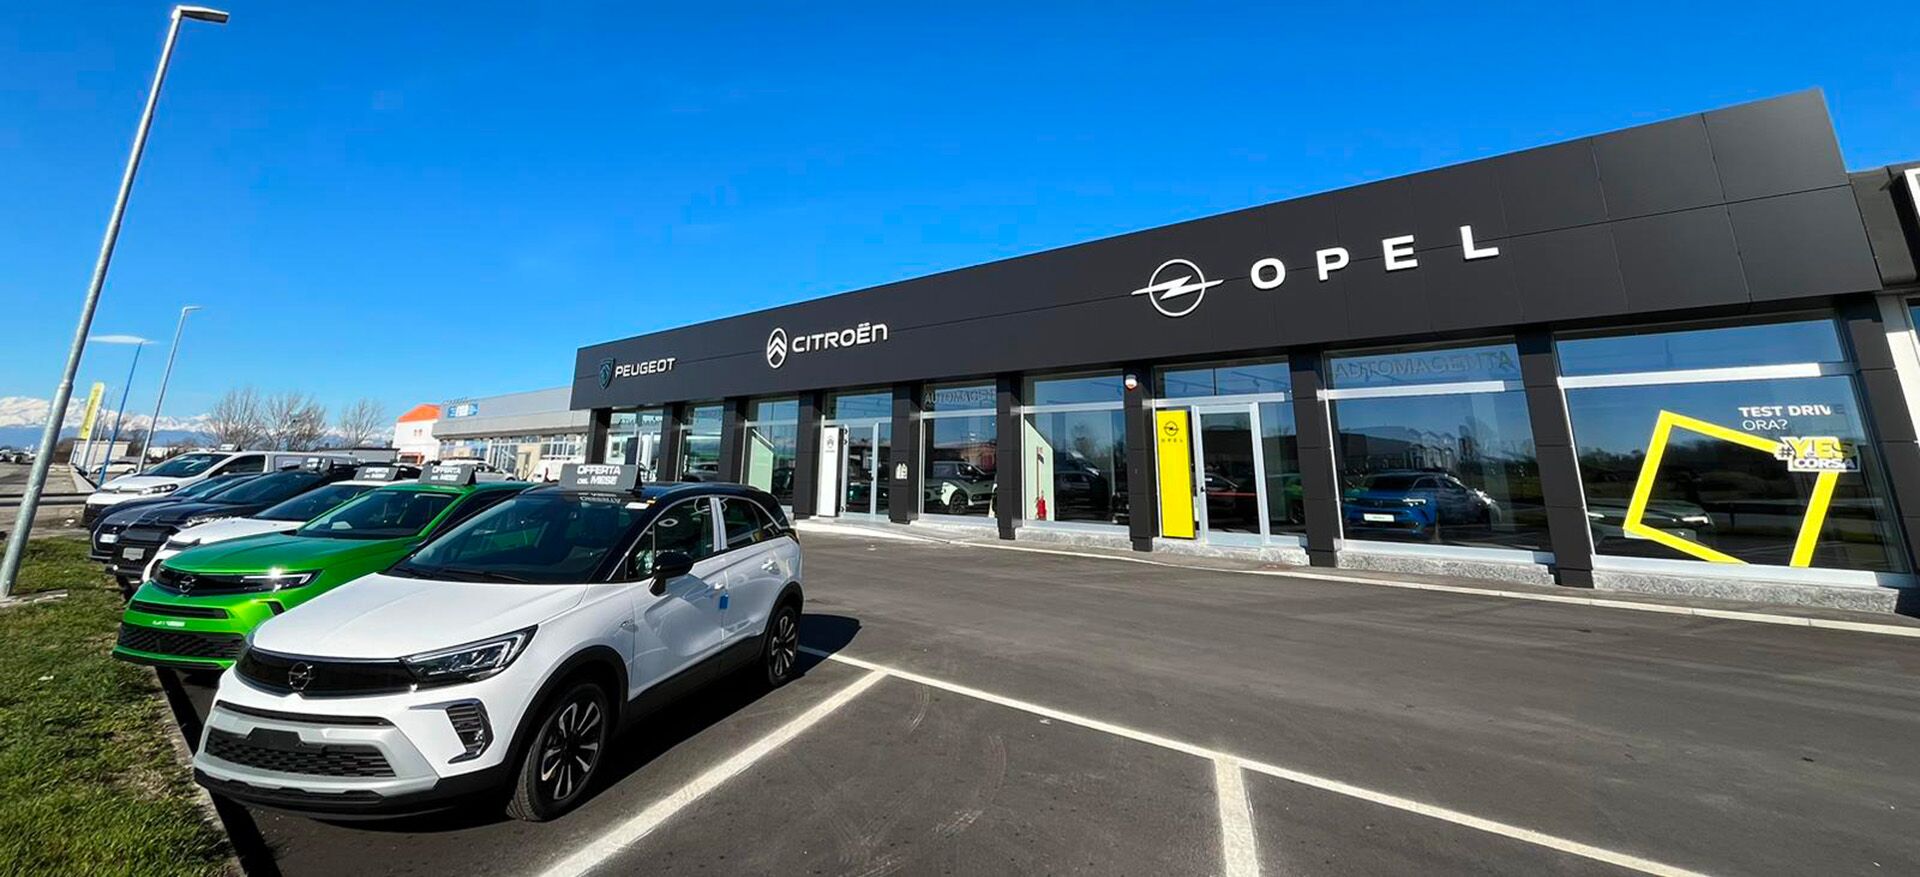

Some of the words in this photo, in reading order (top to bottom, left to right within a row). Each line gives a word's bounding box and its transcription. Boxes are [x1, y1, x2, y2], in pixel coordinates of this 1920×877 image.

[1250, 225, 1499, 289] OPEL
[791, 322, 888, 353] CITROËN
[614, 357, 676, 378] PEUGEOT
[1738, 405, 1783, 417] TEST
[1742, 419, 1788, 431] ORA?
[576, 465, 621, 475] OFFERTA
[1794, 459, 1856, 469] CORSA
[590, 475, 618, 485] MESE
